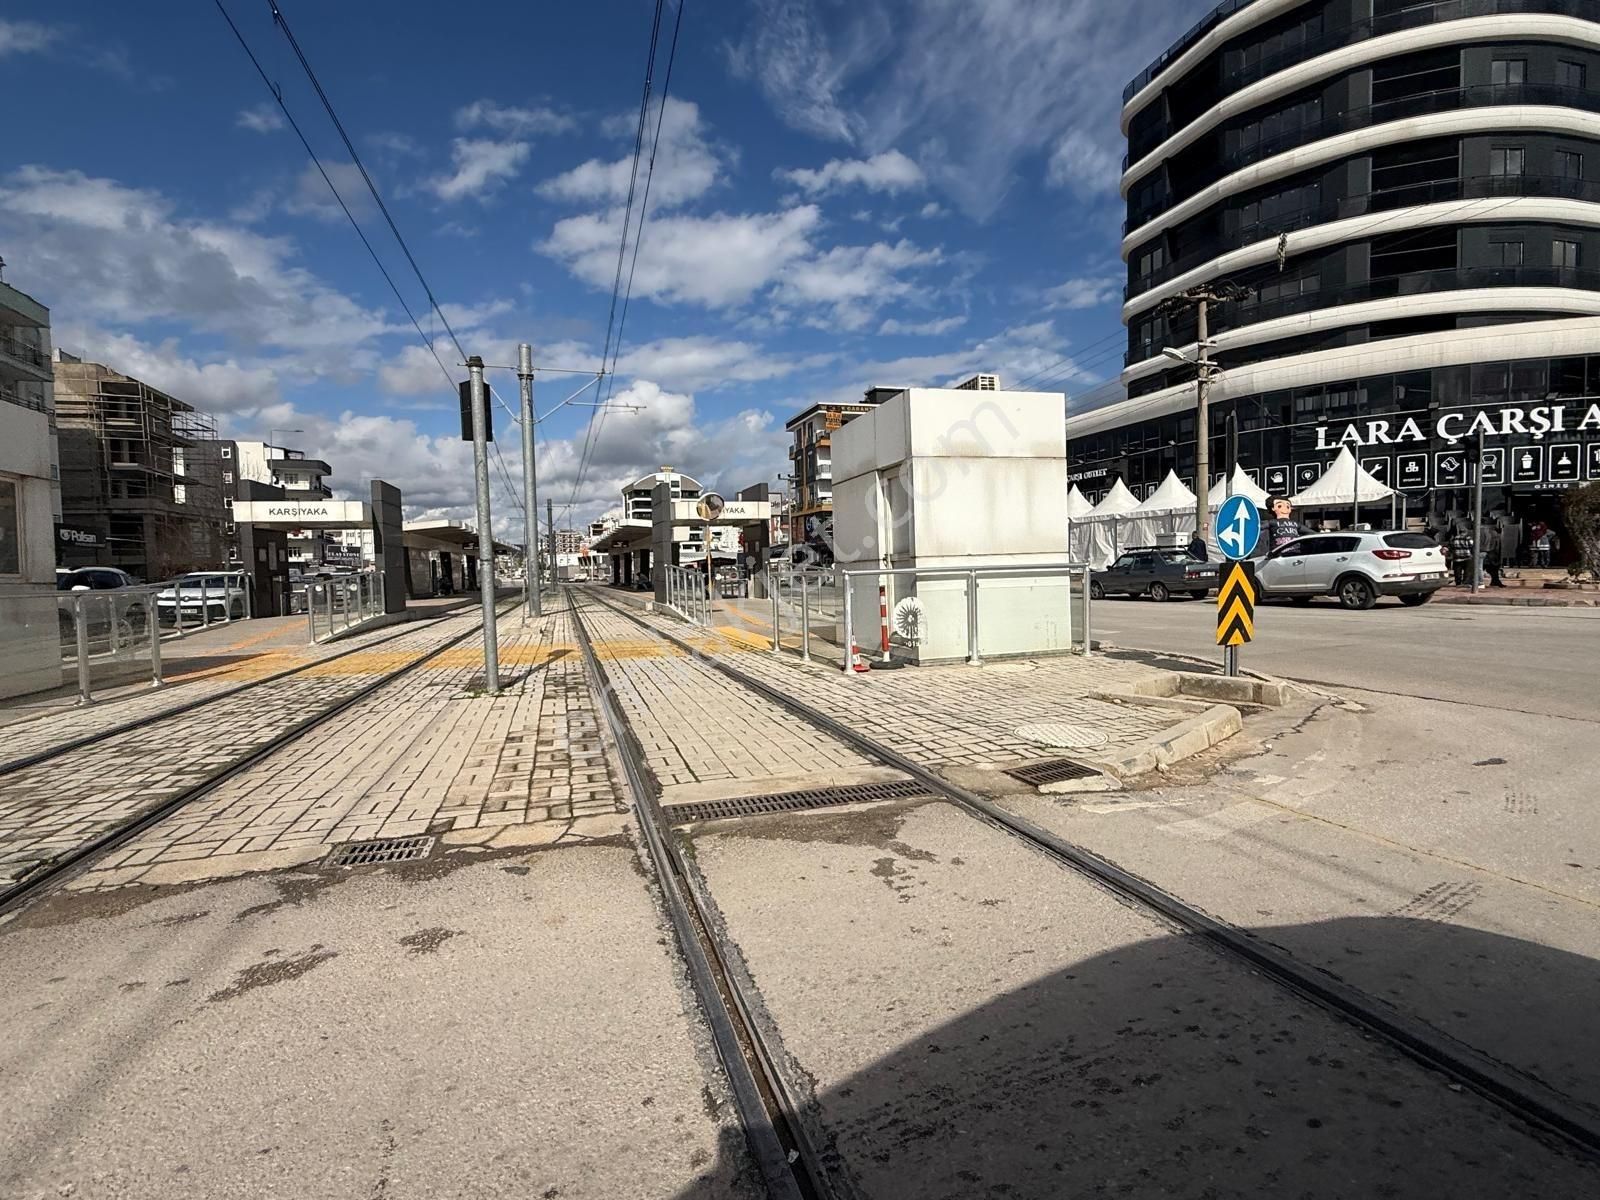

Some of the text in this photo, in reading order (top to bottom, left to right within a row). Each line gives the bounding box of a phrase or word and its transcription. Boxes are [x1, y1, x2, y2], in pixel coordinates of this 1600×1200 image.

[1315, 417, 1426, 450] LARA
[1436, 404, 1566, 445] ÇARŞI
[1083, 467, 1108, 479] OUTLET
[268, 507, 329, 517] KARŞIYAKA
